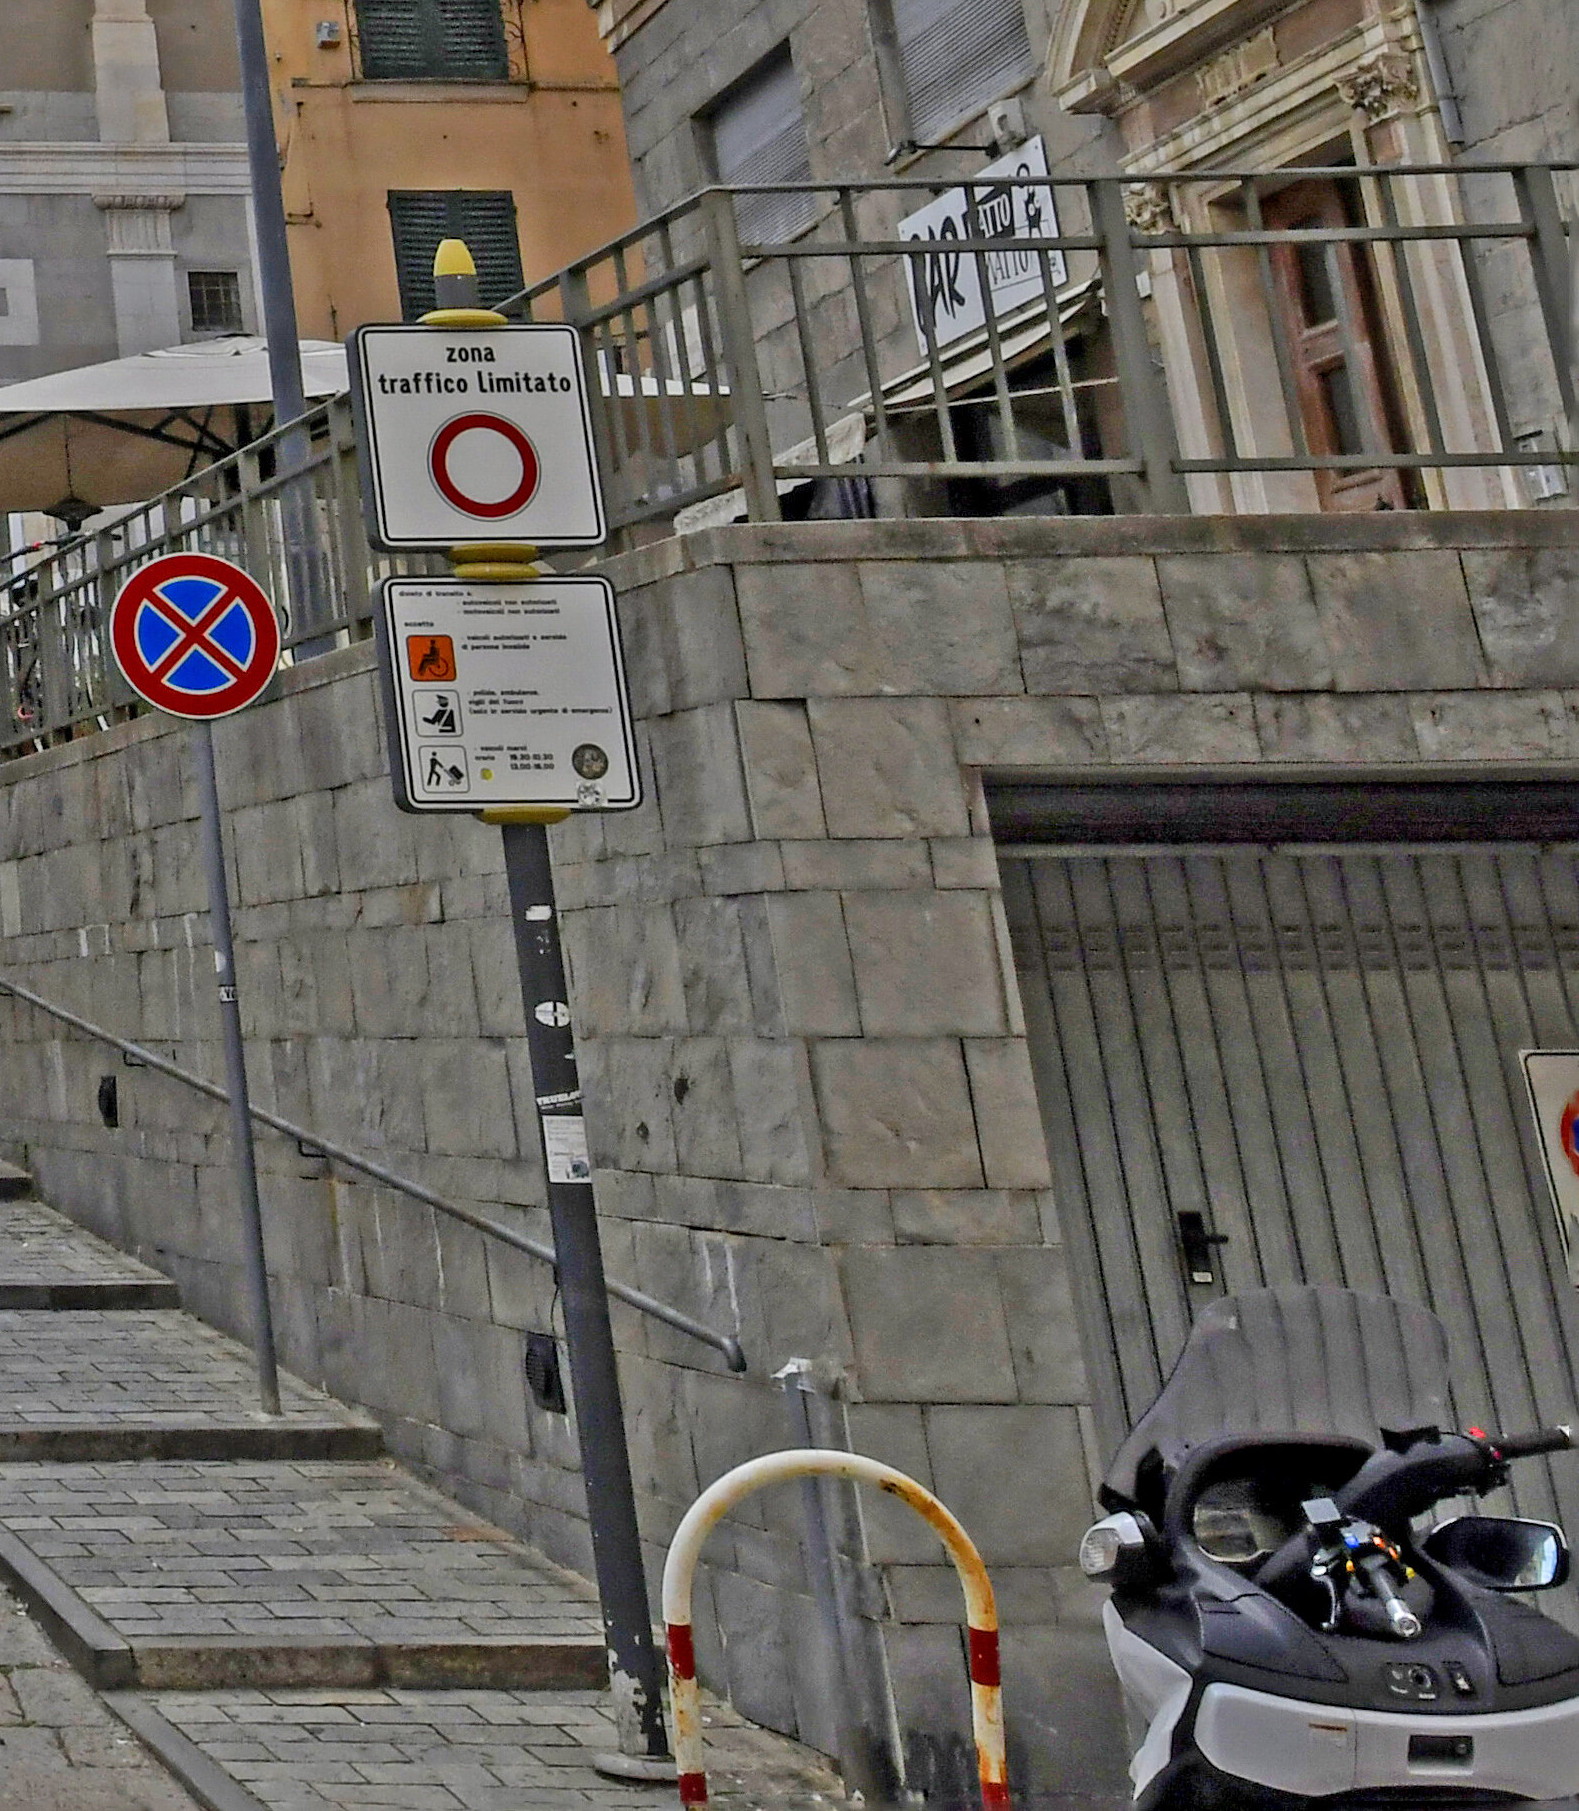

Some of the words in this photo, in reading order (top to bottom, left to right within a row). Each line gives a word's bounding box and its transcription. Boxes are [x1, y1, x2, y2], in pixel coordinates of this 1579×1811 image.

[445, 346, 496, 363] zona
[378, 372, 468, 394] traffico
[477, 370, 571, 393] limitato
